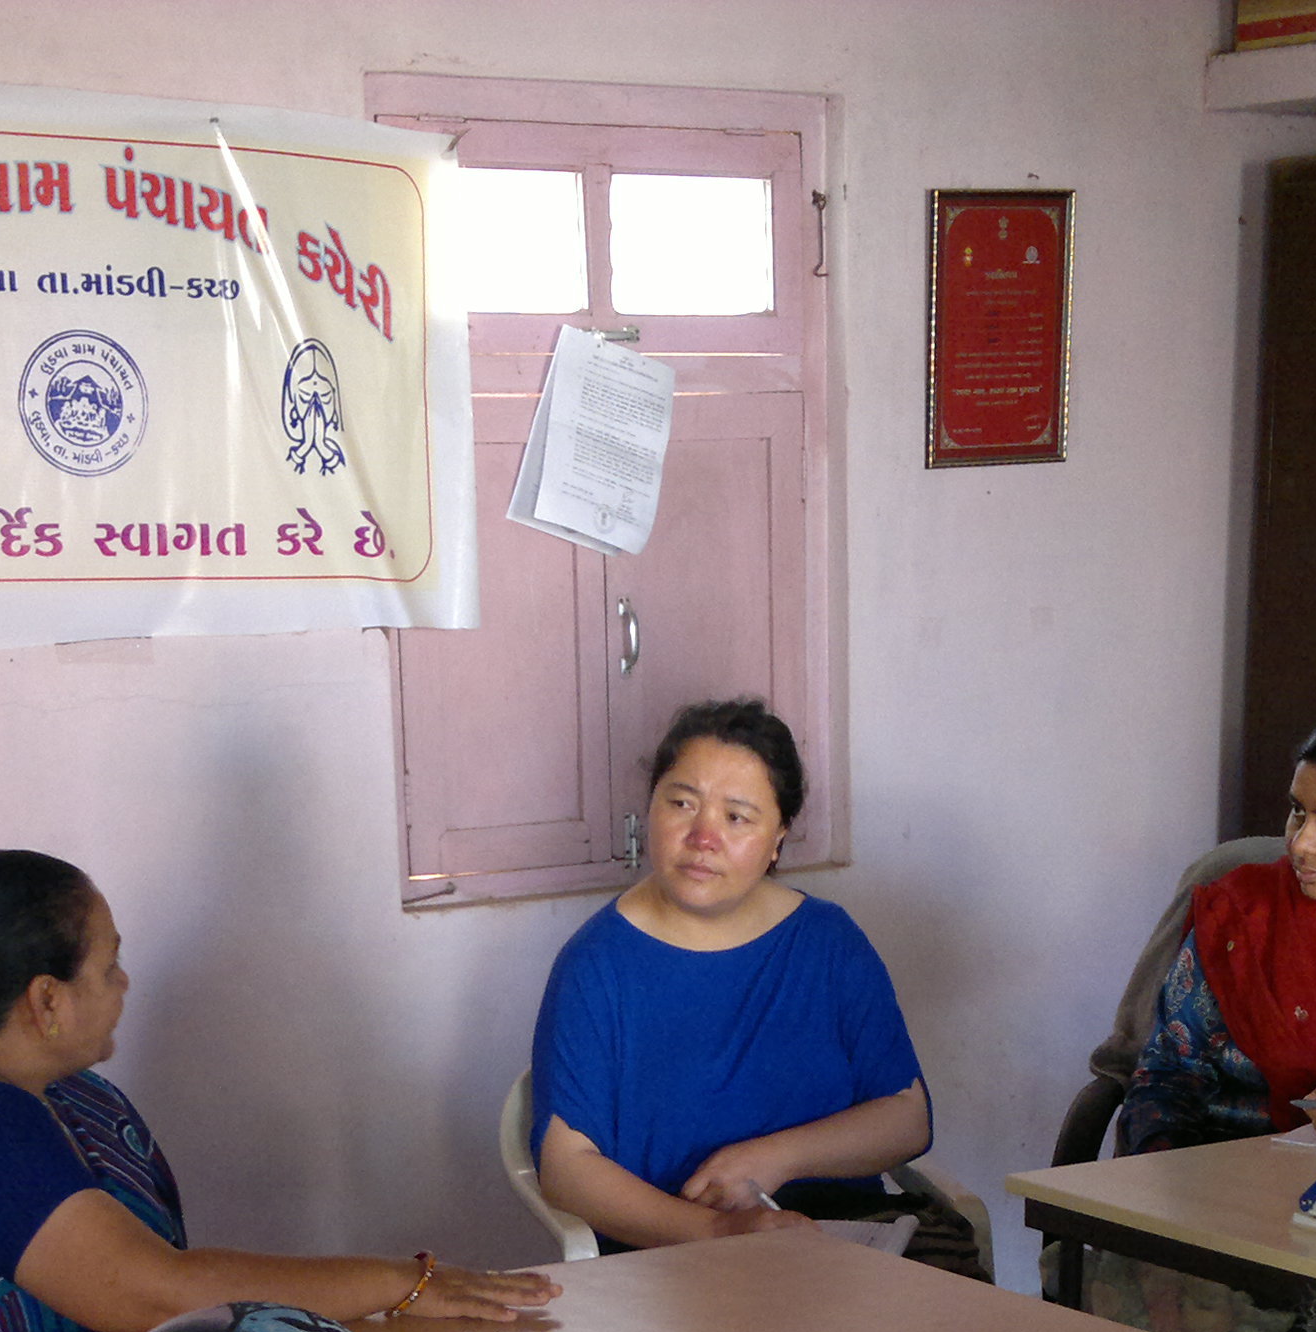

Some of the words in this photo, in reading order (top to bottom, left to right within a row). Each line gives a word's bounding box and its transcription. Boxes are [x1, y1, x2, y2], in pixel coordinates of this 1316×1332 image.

[101, 146, 269, 256] પંચાયત
[296, 221, 394, 343] કચેરી
[40, 346, 69, 376] લુડવા
[93, 522, 248, 557] સ્વાગત
[276, 507, 325, 557] કરે
[353, 510, 396, 560] છે.
